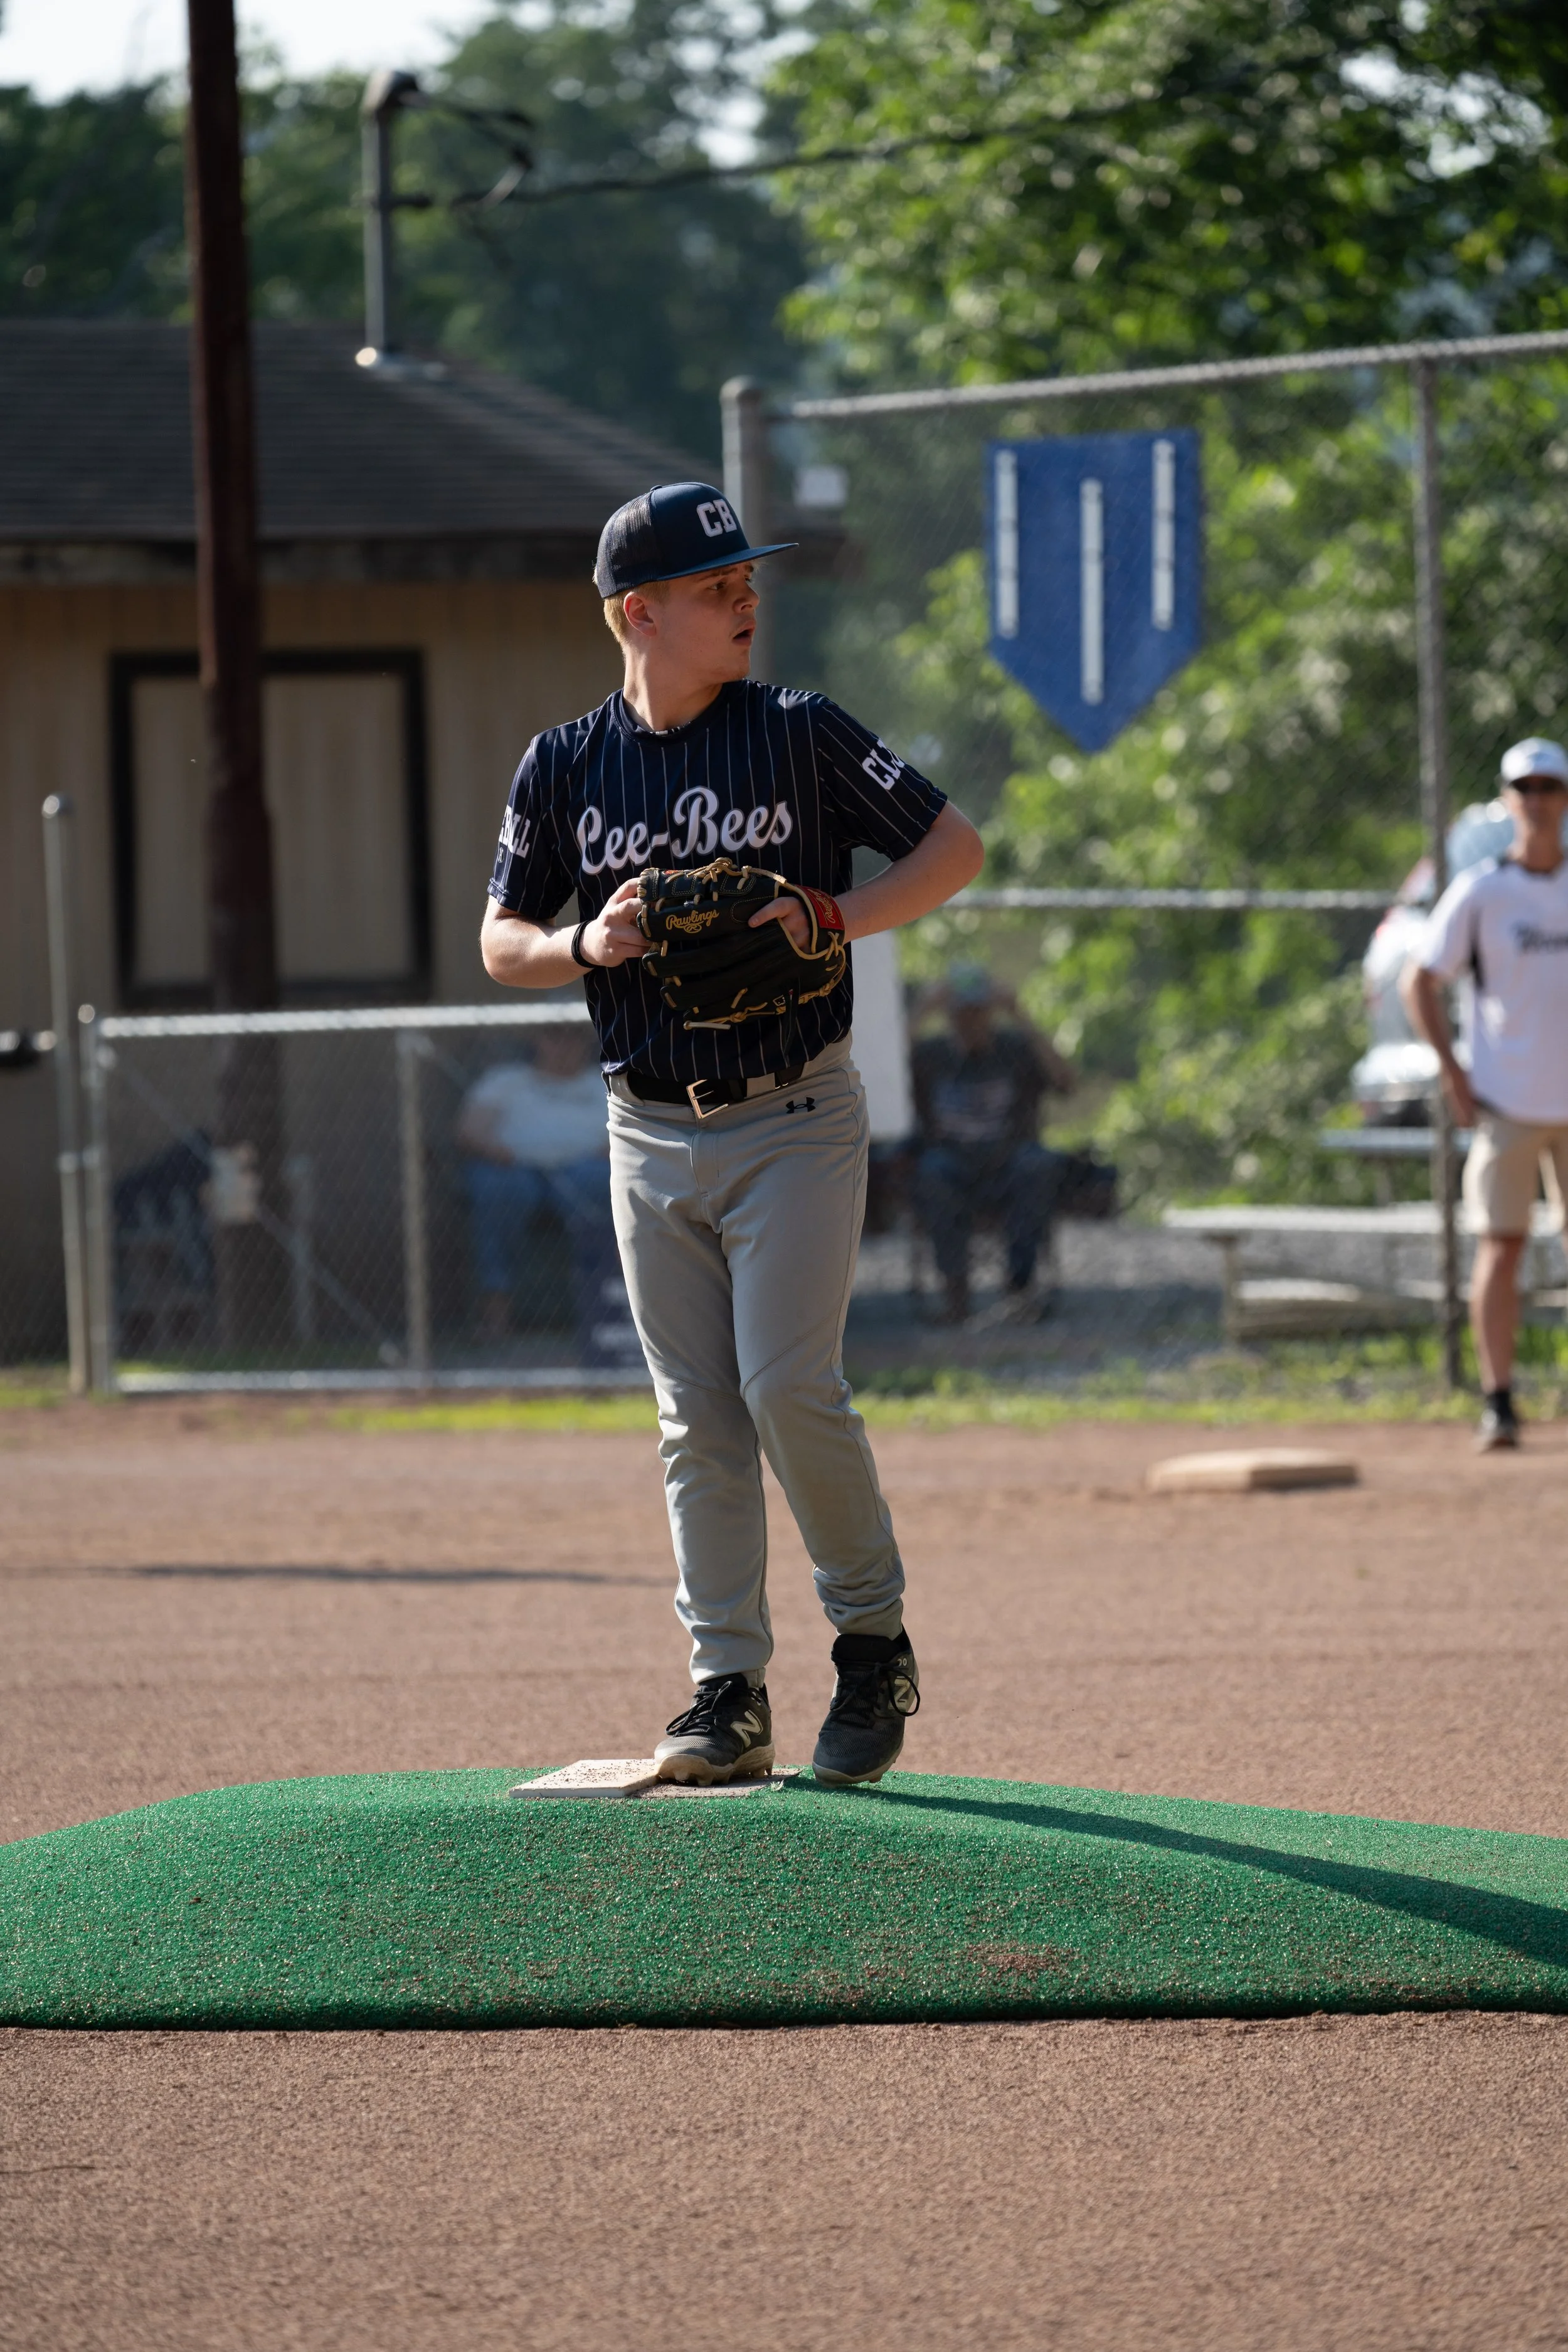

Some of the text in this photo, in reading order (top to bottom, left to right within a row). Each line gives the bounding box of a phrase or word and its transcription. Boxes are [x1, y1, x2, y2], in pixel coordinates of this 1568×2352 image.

[696, 499, 738, 538] CB
[576, 785, 793, 876] Cee-Bees
[665, 908, 719, 930] Rawlings
